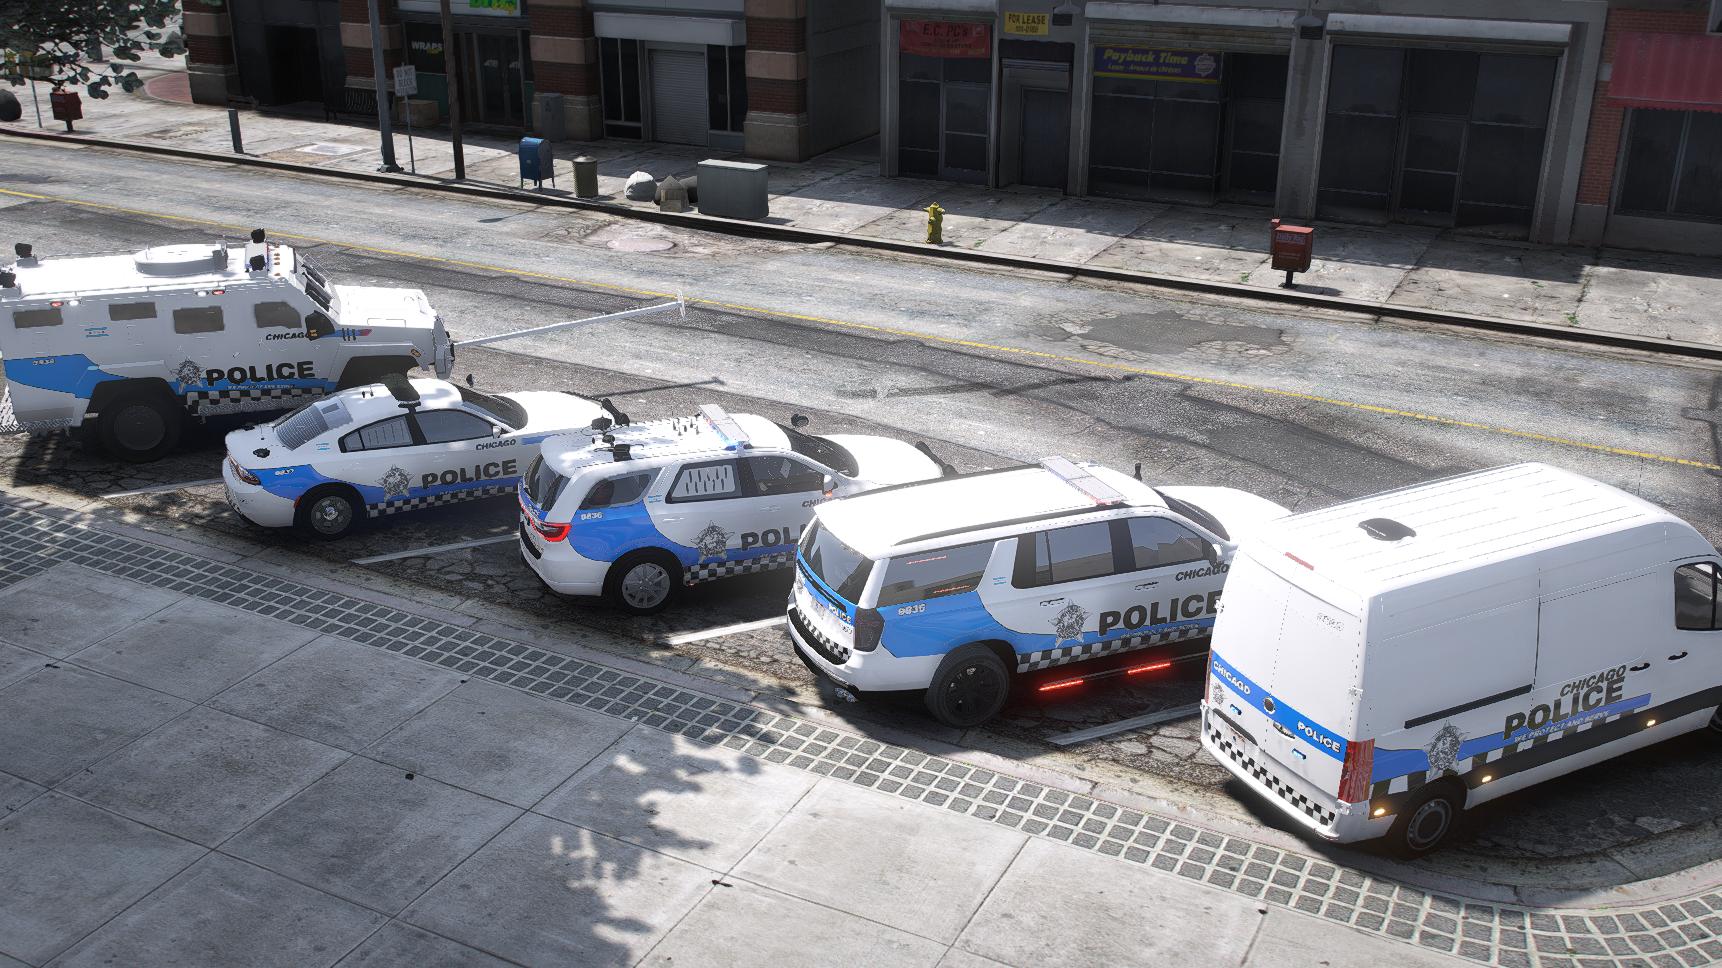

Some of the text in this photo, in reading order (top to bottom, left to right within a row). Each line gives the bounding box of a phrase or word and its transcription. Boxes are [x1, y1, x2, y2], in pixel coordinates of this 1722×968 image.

[1008, 13, 1046, 25] FOR LEASE
[411, 41, 443, 50] WRAPS
[1103, 49, 1155, 64] Payback
[1159, 52, 1189, 65] Time
[265, 332, 309, 341] CHICAG
[205, 361, 317, 387] POLICE
[475, 438, 517, 451] CHICAGO
[421, 458, 518, 489] POLICE
[1175, 563, 1230, 581] CHICAGO
[1098, 590, 1223, 637] POLICE
[1213, 660, 1251, 695] CHICAGO
[1559, 664, 1627, 698] CHICAGO
[1503, 676, 1625, 740] POLICE
[1297, 719, 1342, 754] POLICE
